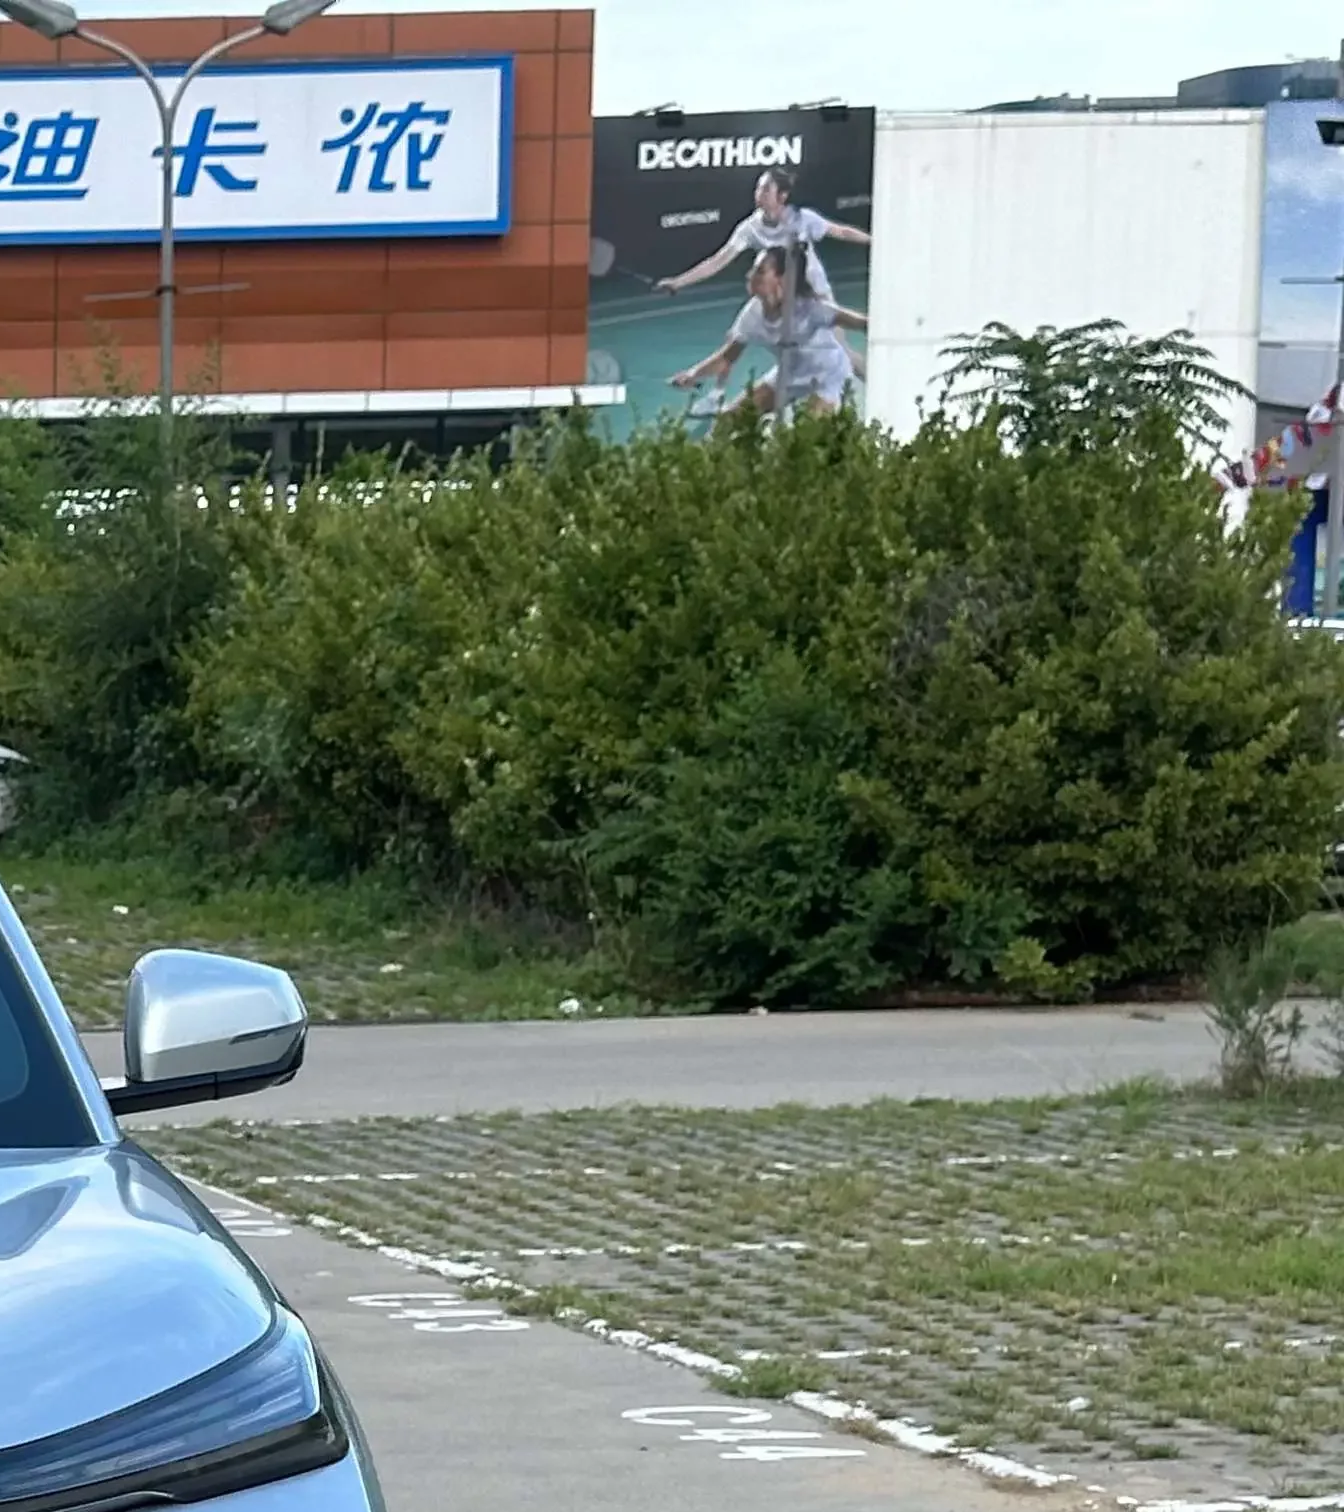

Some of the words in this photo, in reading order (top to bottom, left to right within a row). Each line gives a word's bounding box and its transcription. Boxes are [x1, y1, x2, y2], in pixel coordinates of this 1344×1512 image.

[638, 134, 803, 170] DECATHLON
[347, 1291, 531, 1333] C43
[620, 1404, 870, 1461] C44
